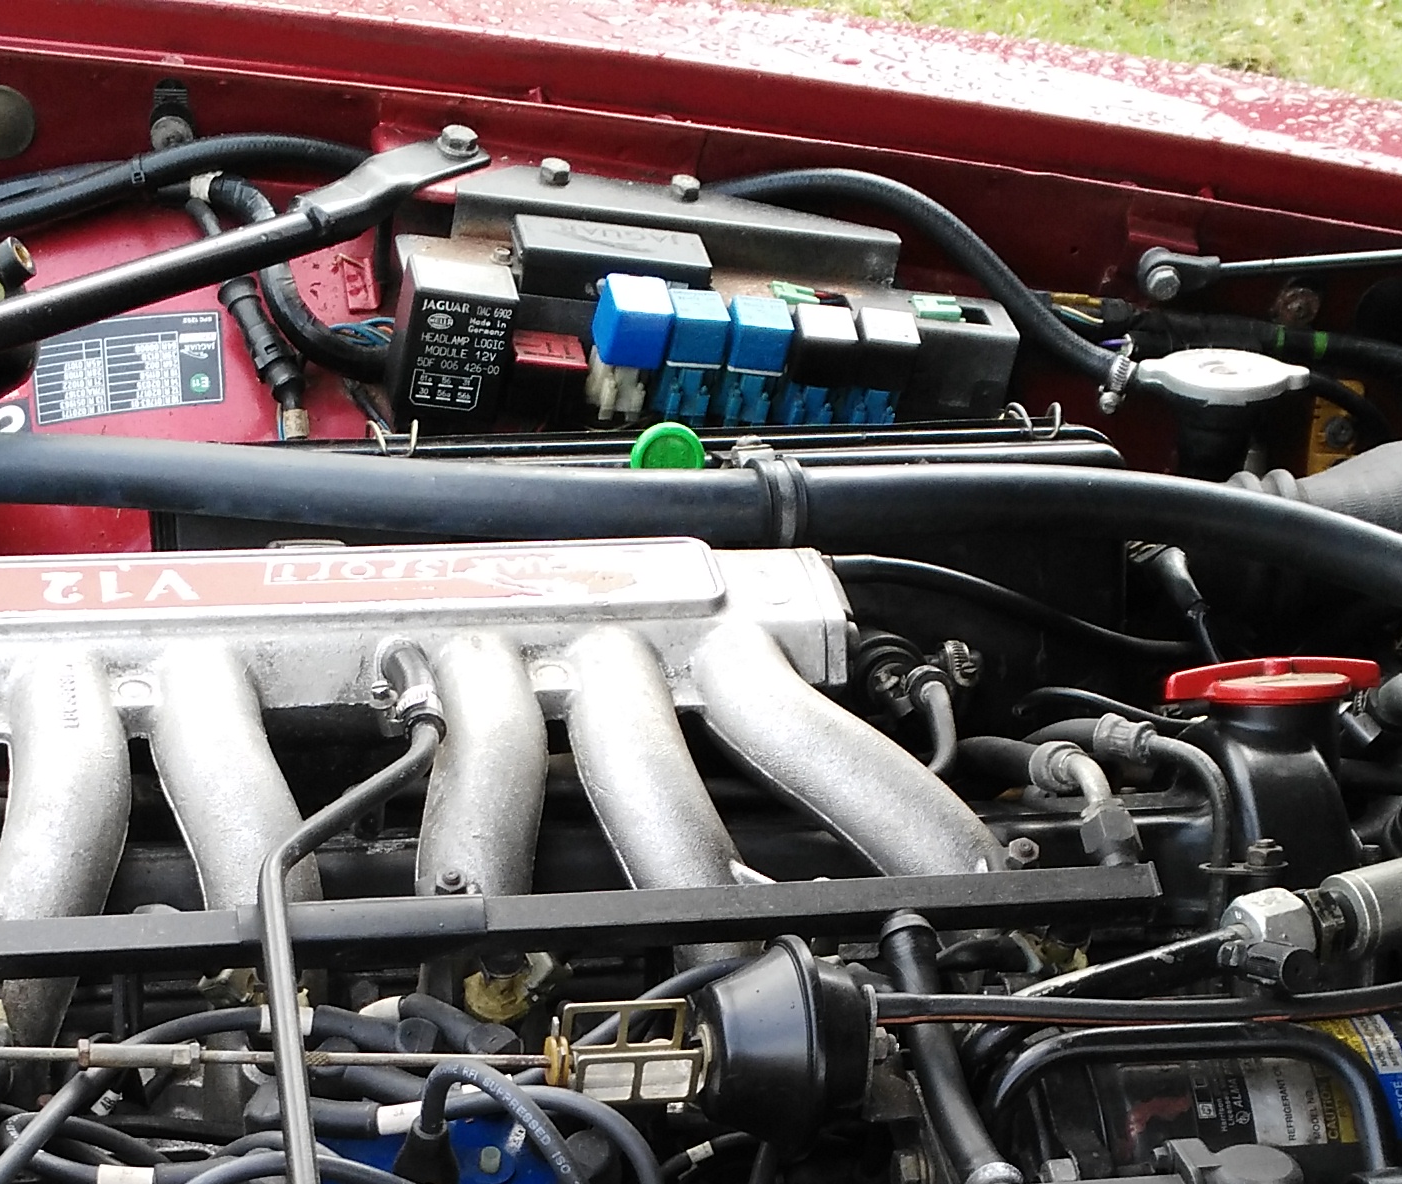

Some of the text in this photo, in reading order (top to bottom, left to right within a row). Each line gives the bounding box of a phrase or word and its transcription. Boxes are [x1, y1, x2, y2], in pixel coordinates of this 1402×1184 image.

[421, 298, 471, 314] JAGUAR
[184, 342, 215, 351] JAGUAR
[421, 331, 470, 347] HEADLAMP
[474, 337, 505, 350] LOGIC
[425, 344, 497, 362] MODULE 12V
[38, 563, 203, 607] V12
[1225, 1095, 1236, 1127] License
[1278, 1079, 1297, 1141] REFRIGERANT
[1310, 1110, 1323, 1140] MODEL
[482, 1077, 552, 1147] SUPPRESSED
[551, 1150, 572, 1175] ISO
